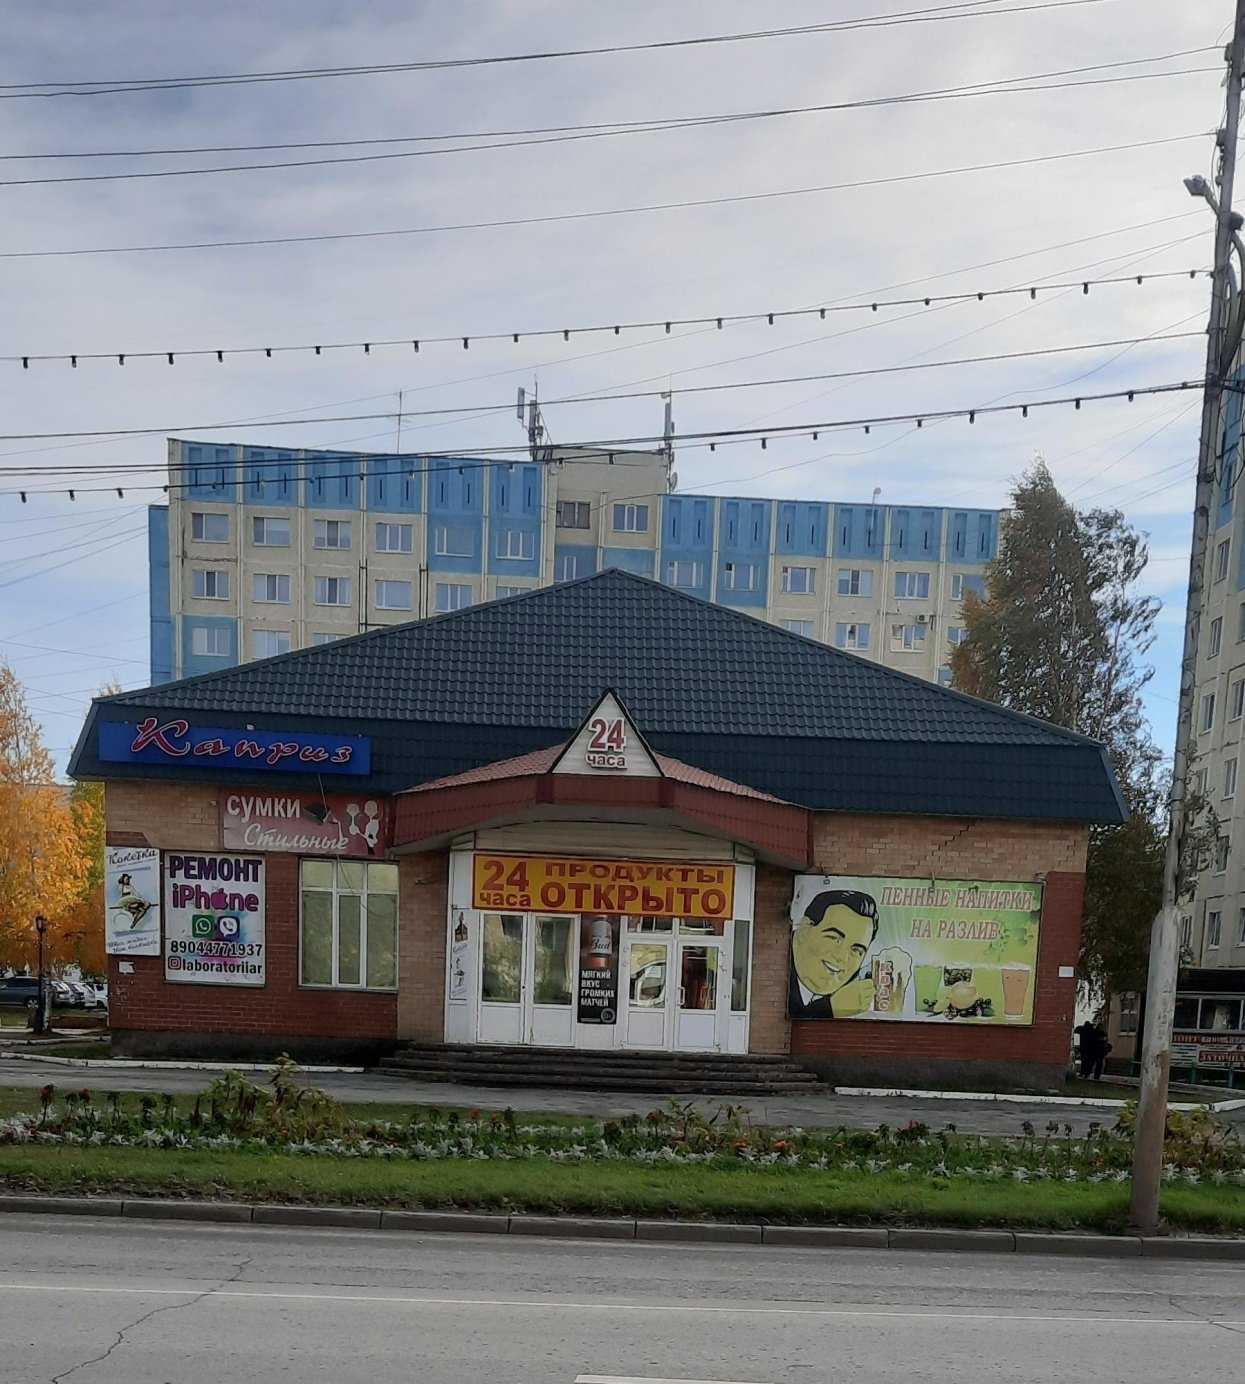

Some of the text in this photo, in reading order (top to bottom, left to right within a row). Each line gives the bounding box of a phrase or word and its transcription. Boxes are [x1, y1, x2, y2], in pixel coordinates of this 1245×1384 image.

[131, 717, 353, 764] Каприз
[588, 718, 626, 752] 24
[585, 753, 626, 769] часа
[244, 824, 349, 850] Стильные
[169, 855, 262, 882] РЕМОНТ
[482, 860, 529, 892] 24
[544, 862, 724, 884] ПРОДУКТЫ
[479, 890, 531, 907] часа
[540, 882, 726, 915] ОТКРЫТО
[880, 886, 1034, 912] ПЕННЫЕ НАПИТКИ
[911, 919, 1000, 941] НА РАЗЛИВ
[170, 940, 262, 956] 89044771937
[581, 979, 600, 988] ВКУС
